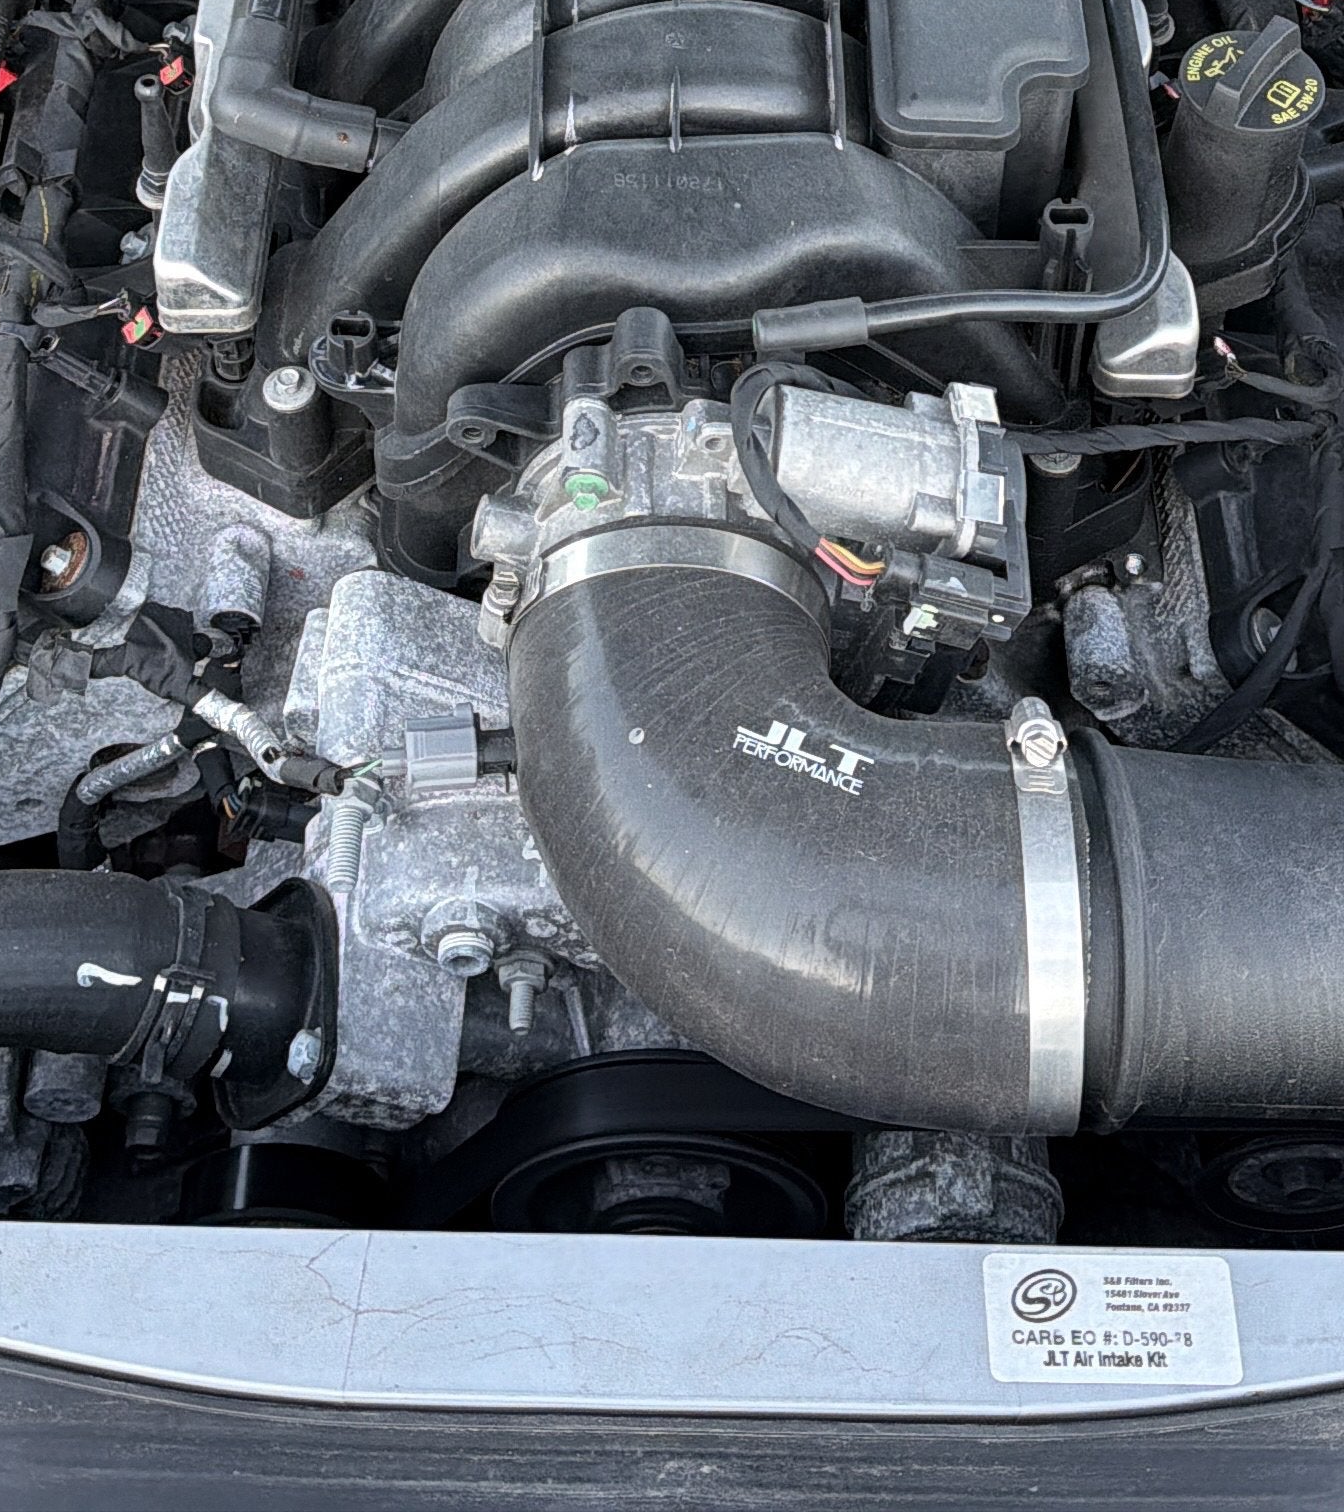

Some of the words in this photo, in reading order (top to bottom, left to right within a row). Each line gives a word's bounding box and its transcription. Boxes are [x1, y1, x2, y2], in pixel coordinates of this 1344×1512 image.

[1187, 44, 1213, 81] ENGINE
[1212, 35, 1238, 50] OIL
[1271, 109, 1300, 125] SAE
[1296, 78, 1318, 111] 5W-20
[737, 720, 875, 776] JLT
[733, 734, 864, 796] PERFORMANCE
[1124, 1276, 1154, 1286] Filters
[1162, 1290, 1181, 1299] Ave
[1147, 1302, 1160, 1313] CA
[1071, 1329, 1097, 1346] EO
[1043, 1350, 1070, 1368] JLT
[1073, 1350, 1095, 1368] Air
[1098, 1350, 1143, 1368] Intake
[1147, 1350, 1169, 1369] Kit
